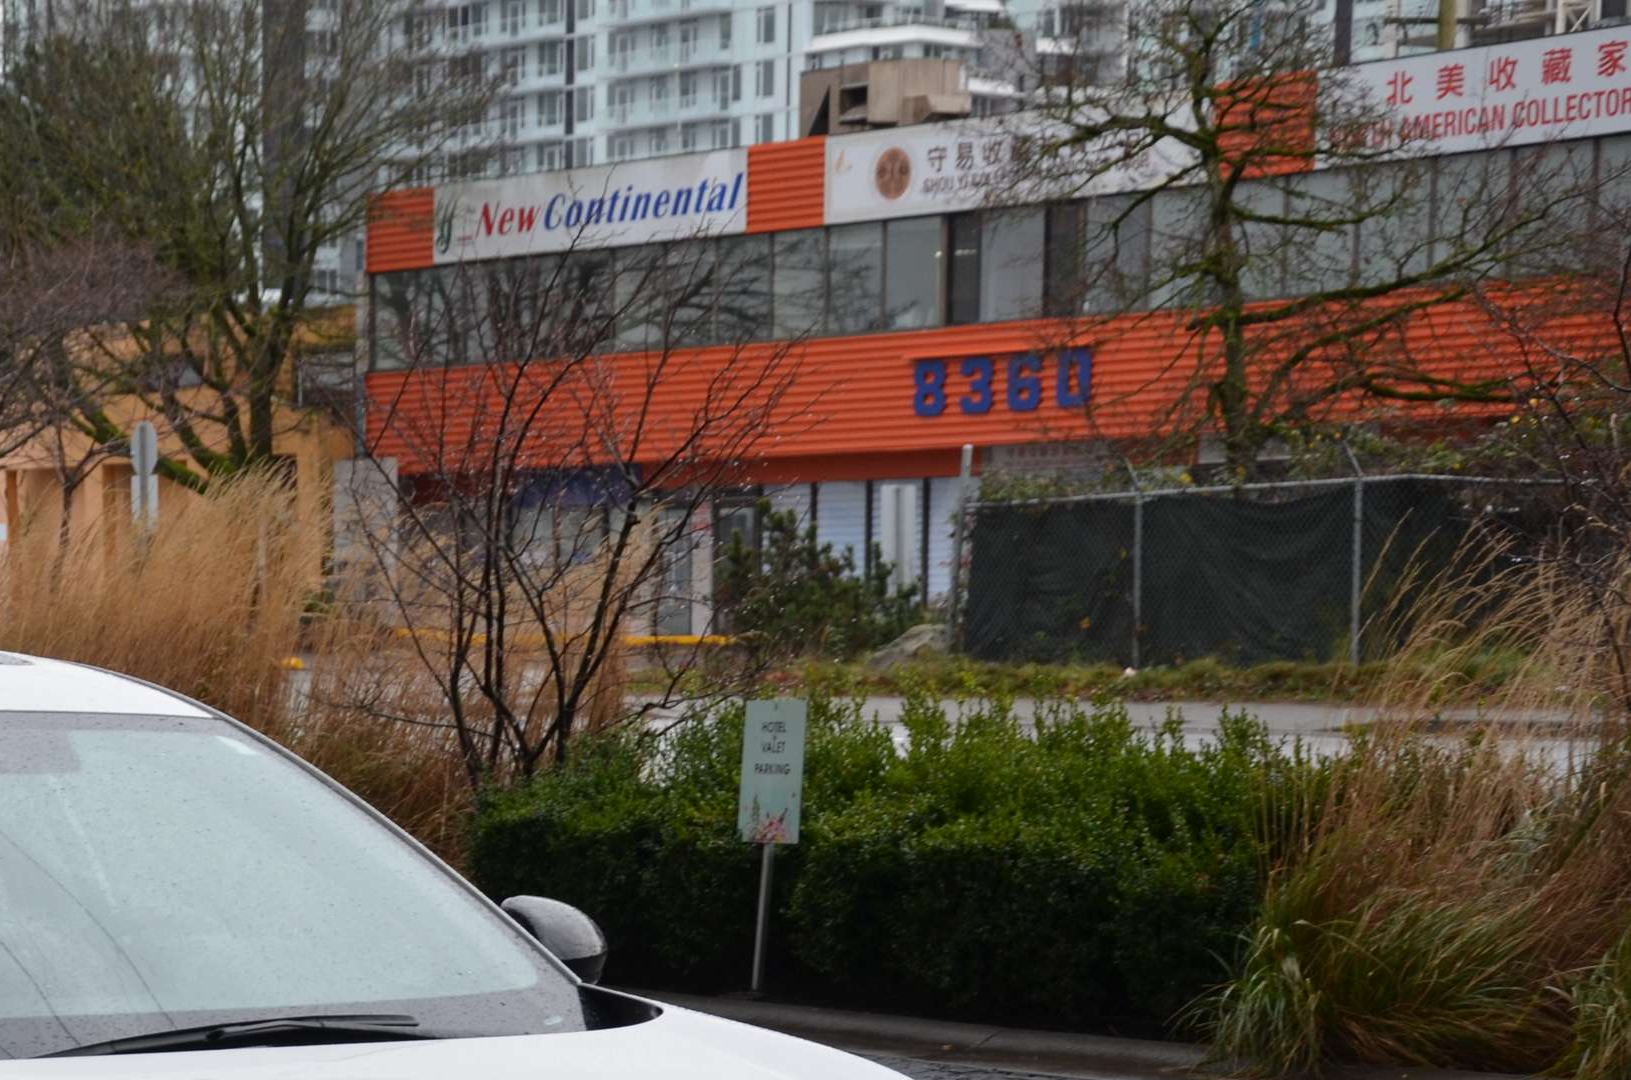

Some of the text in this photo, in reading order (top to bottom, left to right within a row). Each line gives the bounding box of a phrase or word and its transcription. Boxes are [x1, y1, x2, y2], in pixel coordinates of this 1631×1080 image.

[1386, 40, 1629, 106] 北美收藏家
[1399, 104, 1506, 143] AMERICAN
[475, 172, 744, 238] New Continental
[913, 347, 1093, 417] 8360
